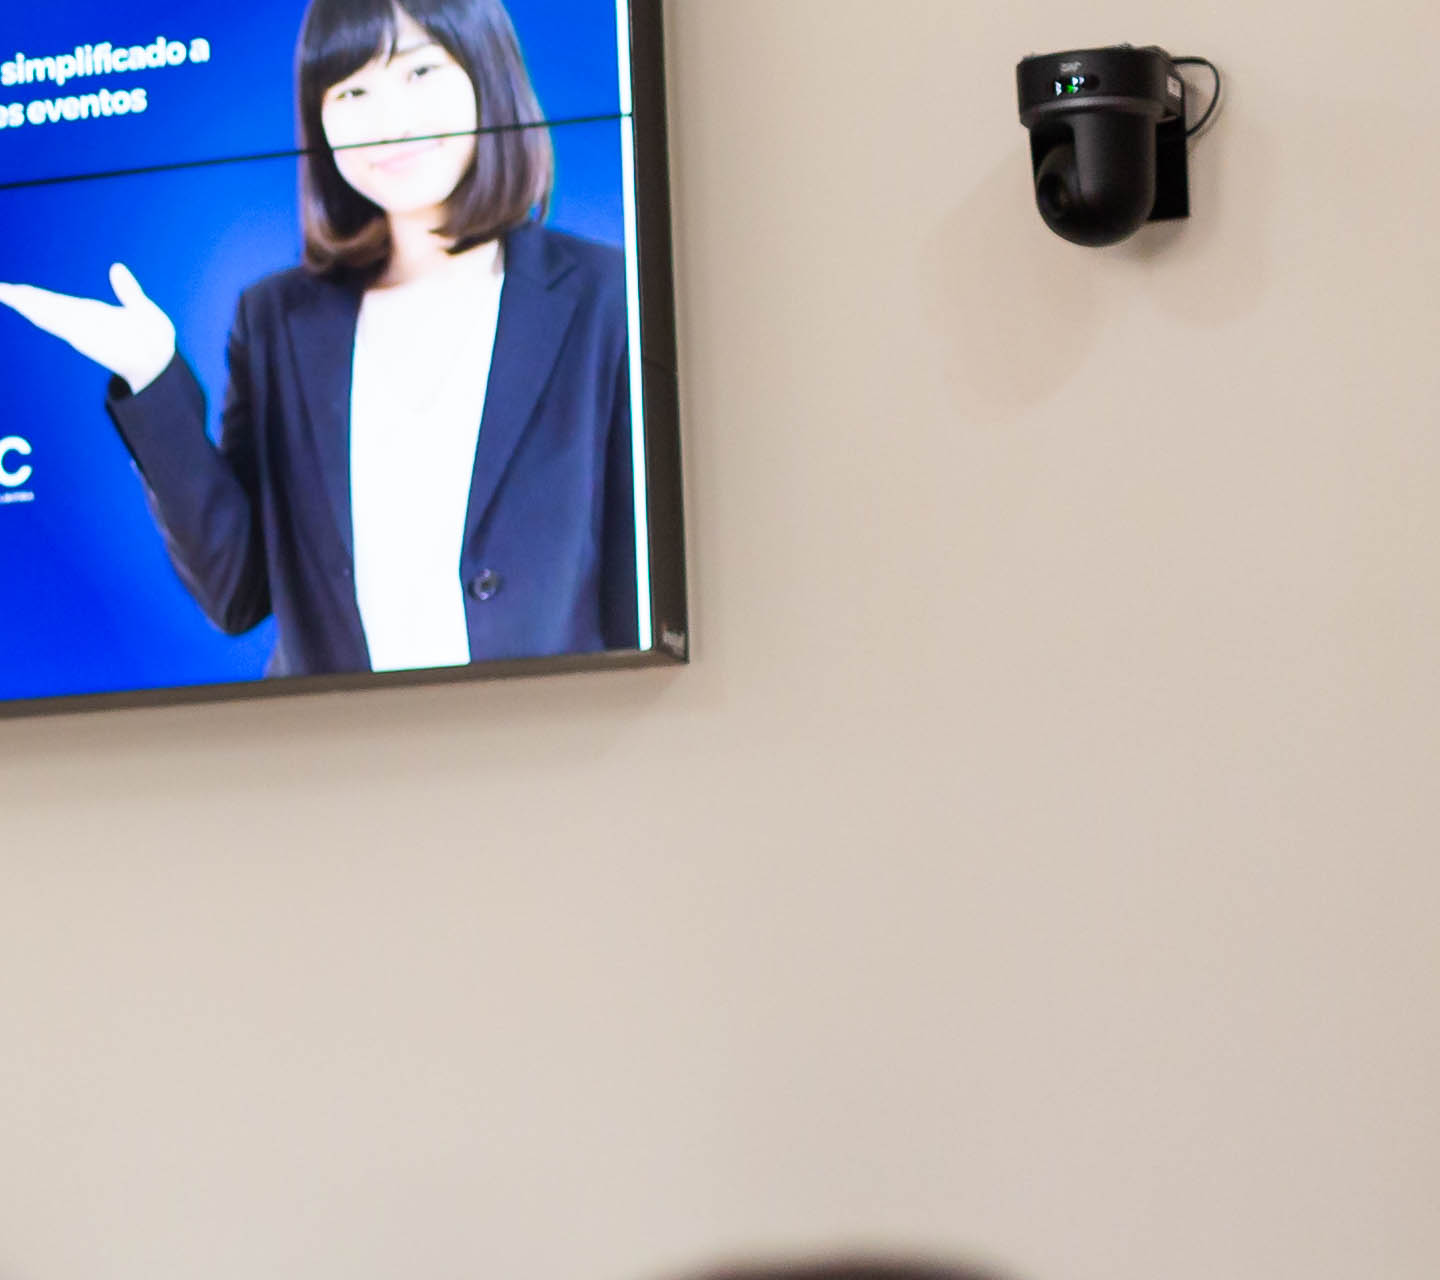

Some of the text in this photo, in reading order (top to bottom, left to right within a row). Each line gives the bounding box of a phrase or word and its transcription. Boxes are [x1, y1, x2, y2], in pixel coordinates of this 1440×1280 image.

[3, 36, 187, 87] simplificado
[190, 40, 210, 63] a
[28, 84, 148, 129] eventos
